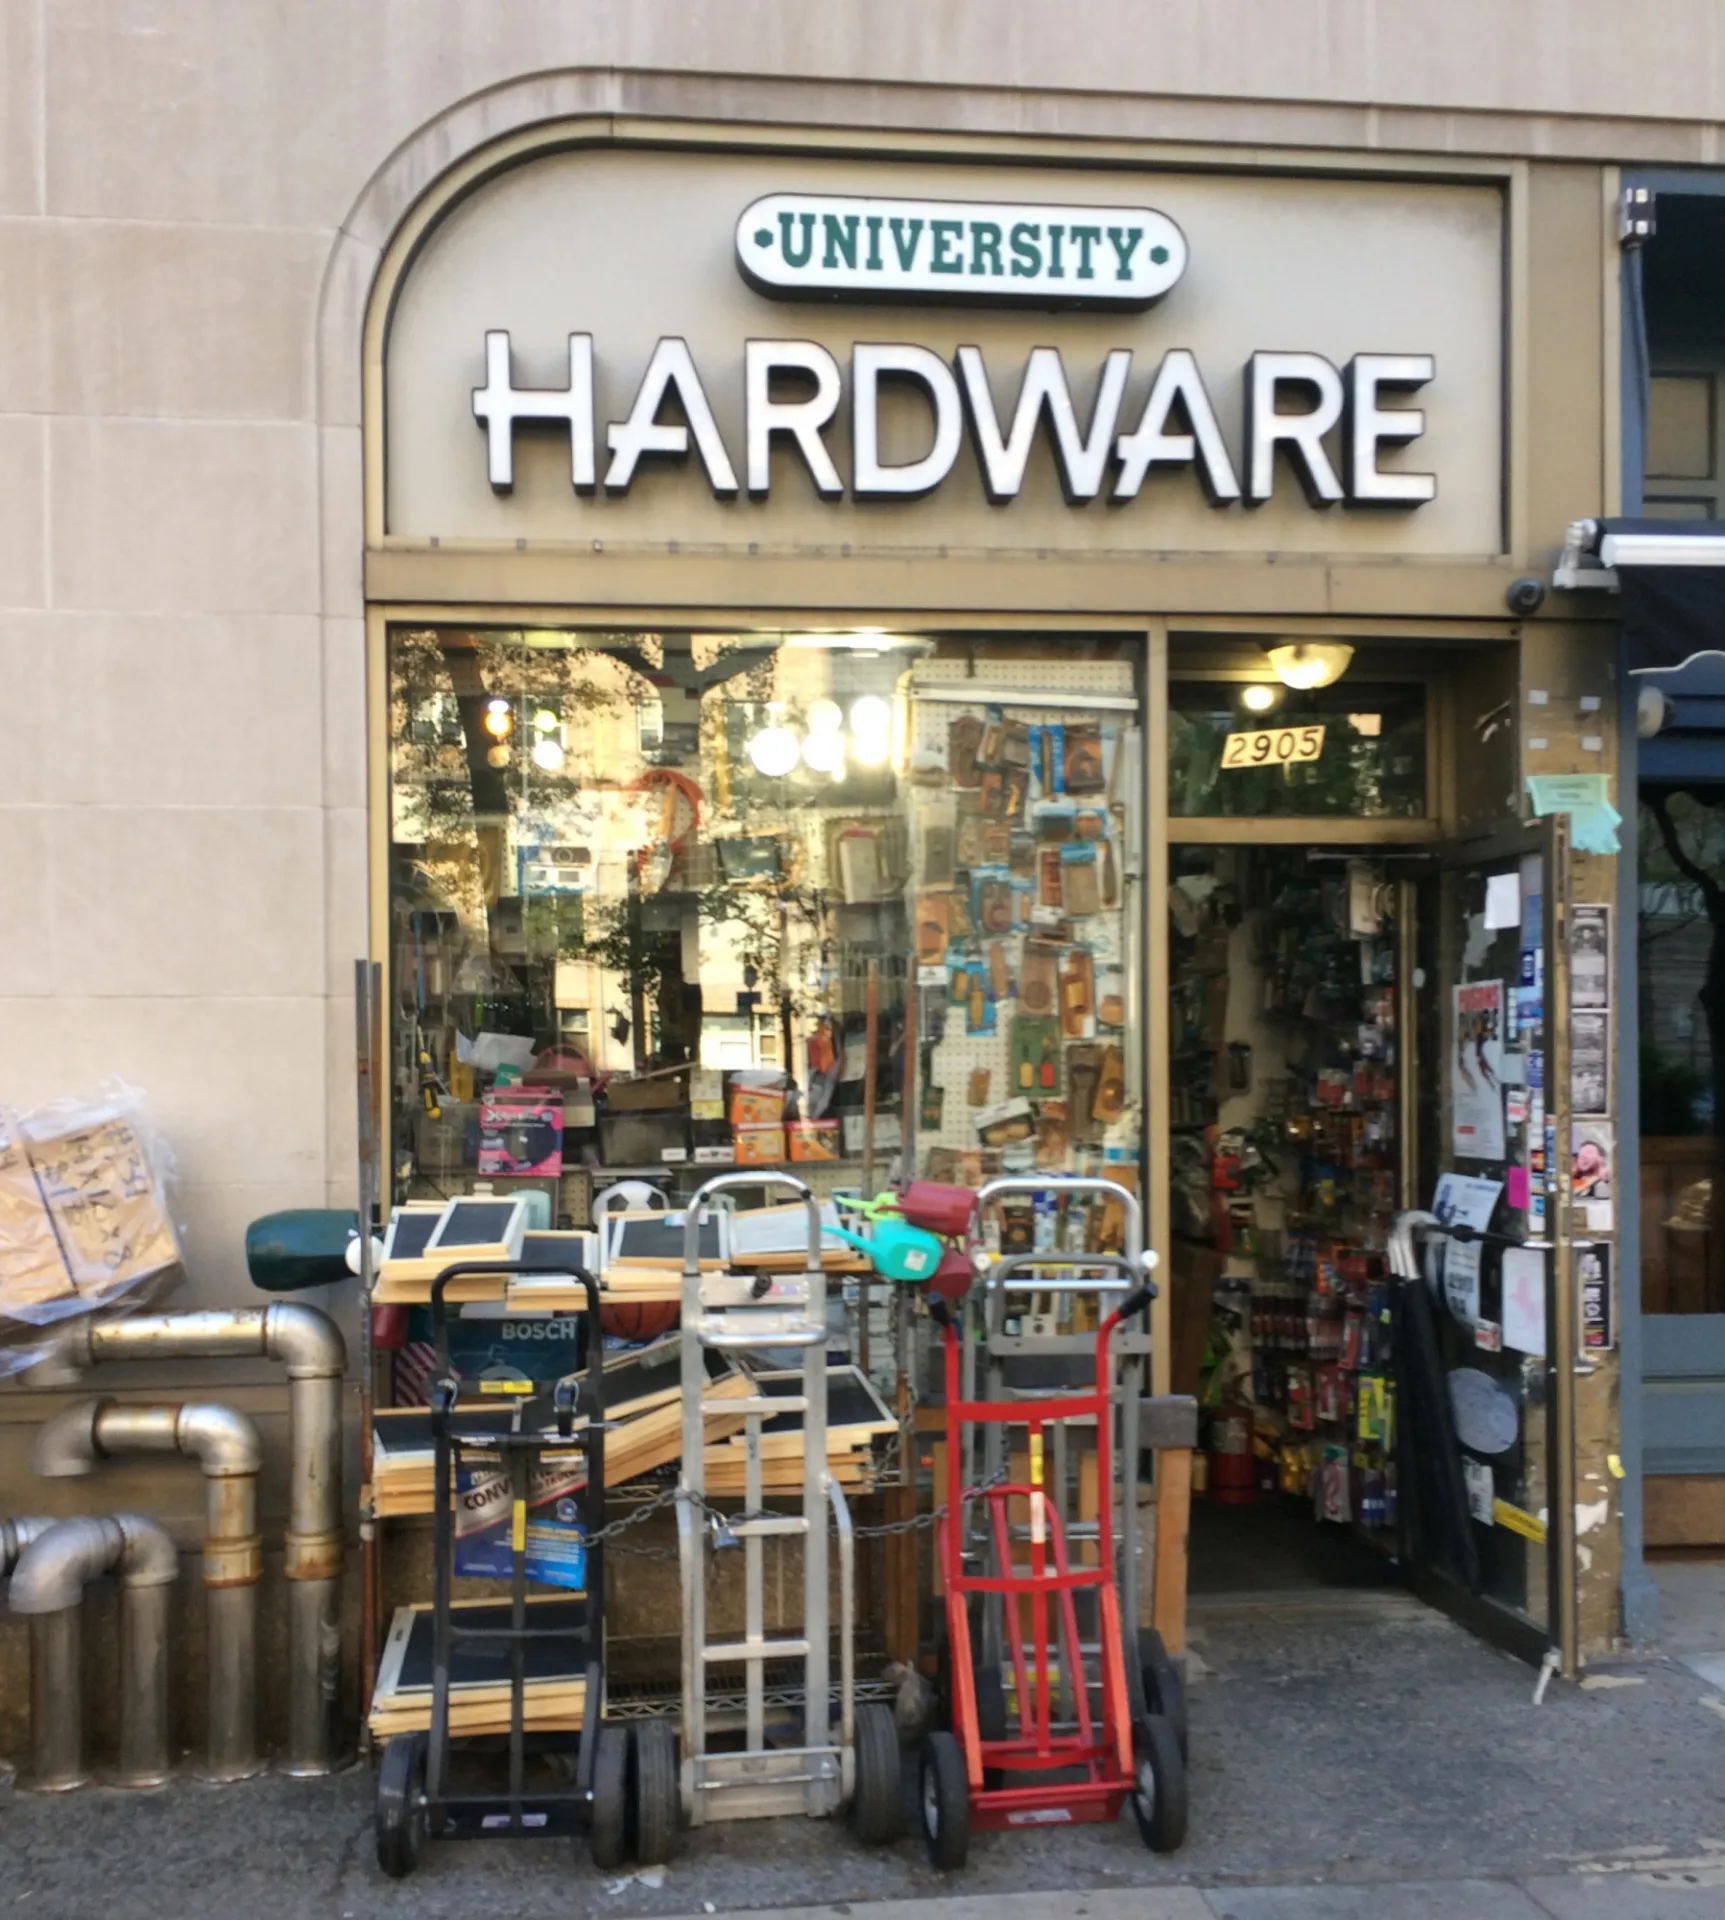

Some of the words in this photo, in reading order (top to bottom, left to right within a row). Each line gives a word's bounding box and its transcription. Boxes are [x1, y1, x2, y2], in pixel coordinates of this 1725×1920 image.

[776, 210, 1144, 282] UNIVERSITY
[471, 329, 1437, 502] HARDWARE
[1226, 727, 1320, 766] 2905
[501, 1322, 576, 1340] BOSCH
[463, 1475, 516, 1511] CONV
